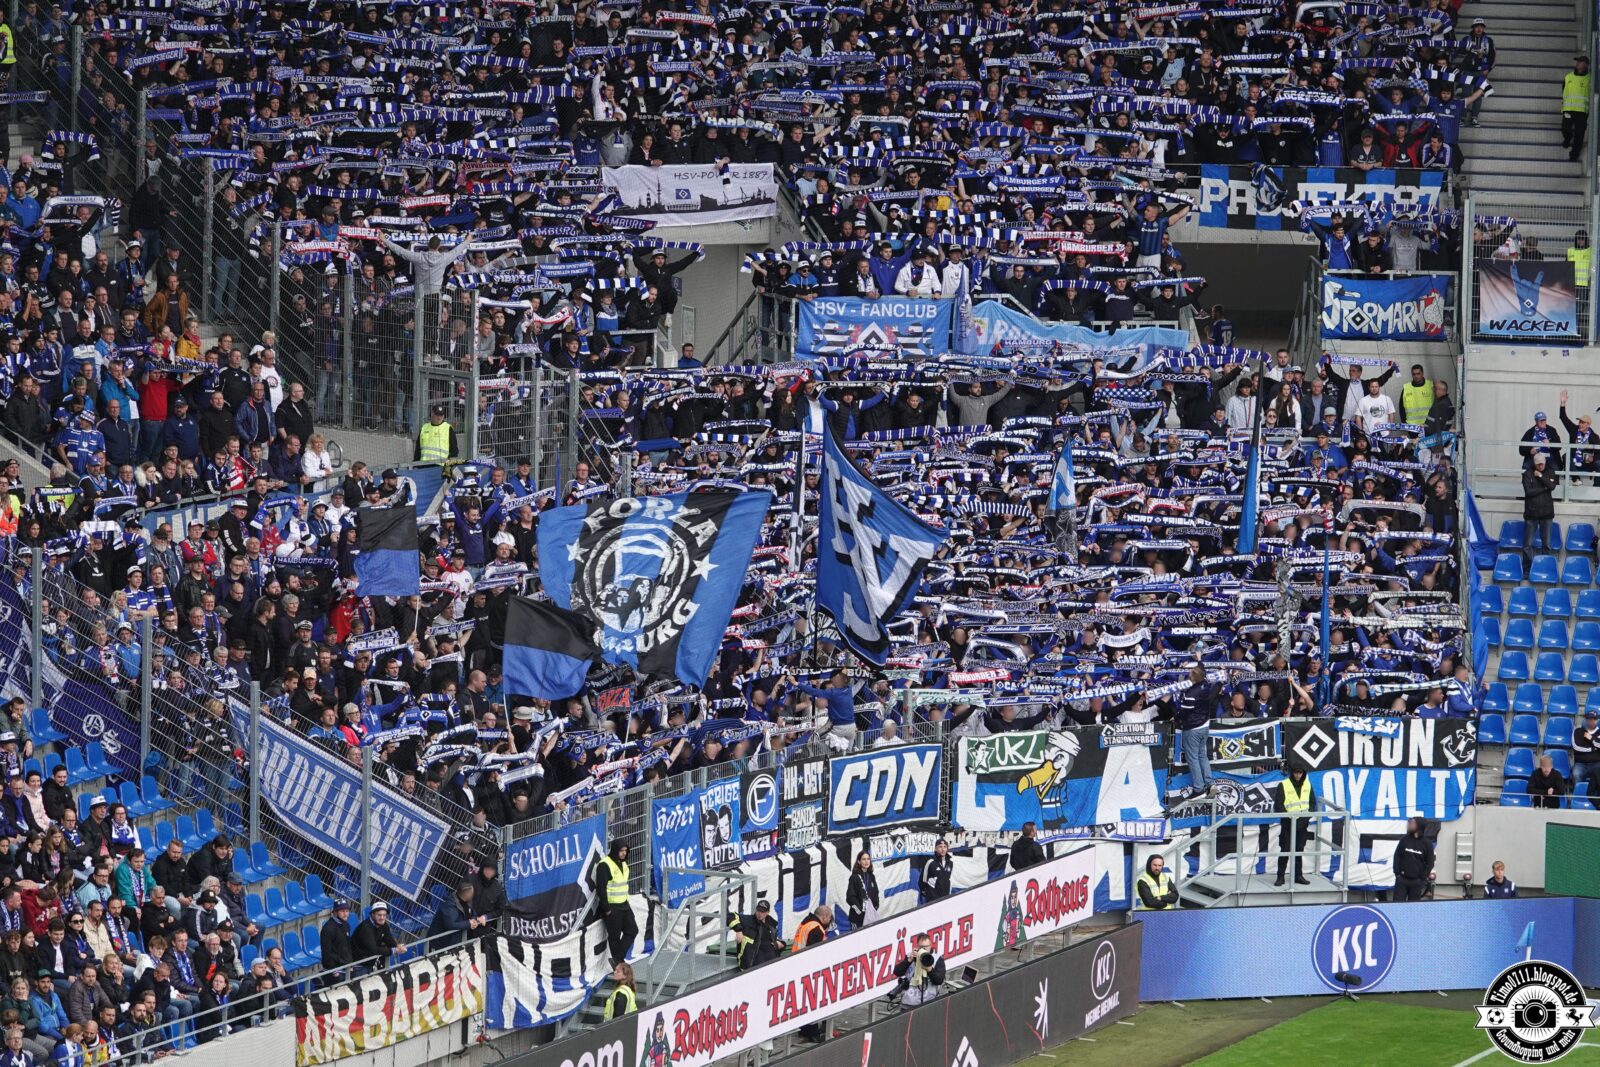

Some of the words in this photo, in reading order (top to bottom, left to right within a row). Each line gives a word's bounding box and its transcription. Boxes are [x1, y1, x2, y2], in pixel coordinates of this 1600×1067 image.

[1139, 4, 1183, 19] HAMBURGER
[1212, 9, 1256, 17] HAMBURGER
[133, 51, 178, 66] DERBYSIEGER
[1223, 54, 1265, 62] HAMBURGER
[651, 62, 689, 71] HAMBURGER
[1046, 92, 1094, 101] HAMBURGER
[1253, 115, 1287, 125] HOLSTEN
[504, 126, 551, 135] HAMBURG
[674, 172, 739, 181] HSV-POWR
[743, 170, 768, 181] 1887
[999, 175, 1045, 185] HAMBURGER
[1007, 186, 1055, 194] HAMBURGER
[596, 213, 647, 229] HAMBURG
[391, 231, 459, 242] CASTAWAYS
[1023, 230, 1073, 240] HAMBURGER
[290, 241, 339, 252] HAMBURGER
[1061, 241, 1118, 253] HAMBURGER
[814, 302, 847, 316] HSV
[861, 303, 937, 318] FANCLUB
[1489, 319, 1570, 332] WACKEN
[1004, 339, 1053, 347] HAMBURG
[681, 393, 722, 401] HAMBURGER
[1004, 453, 1053, 463] HAMBURGER
[1117, 456, 1145, 468] NORD
[584, 497, 718, 547] FORZA
[1127, 515, 1153, 524] NORD
[276, 557, 323, 565] HAMBURGER
[1073, 682, 1135, 700] CASTAWAYS
[1116, 723, 1144, 733] SEKTION
[832, 751, 938, 823] CDN
[509, 833, 584, 881] SCHOLLI
[1023, 874, 1091, 928] Rothaus
[1332, 921, 1379, 974] KSC
[1095, 951, 1112, 988] KSC
[671, 1001, 749, 1063] Rothaus
[767, 912, 974, 1029] TANNENZÄFLE
